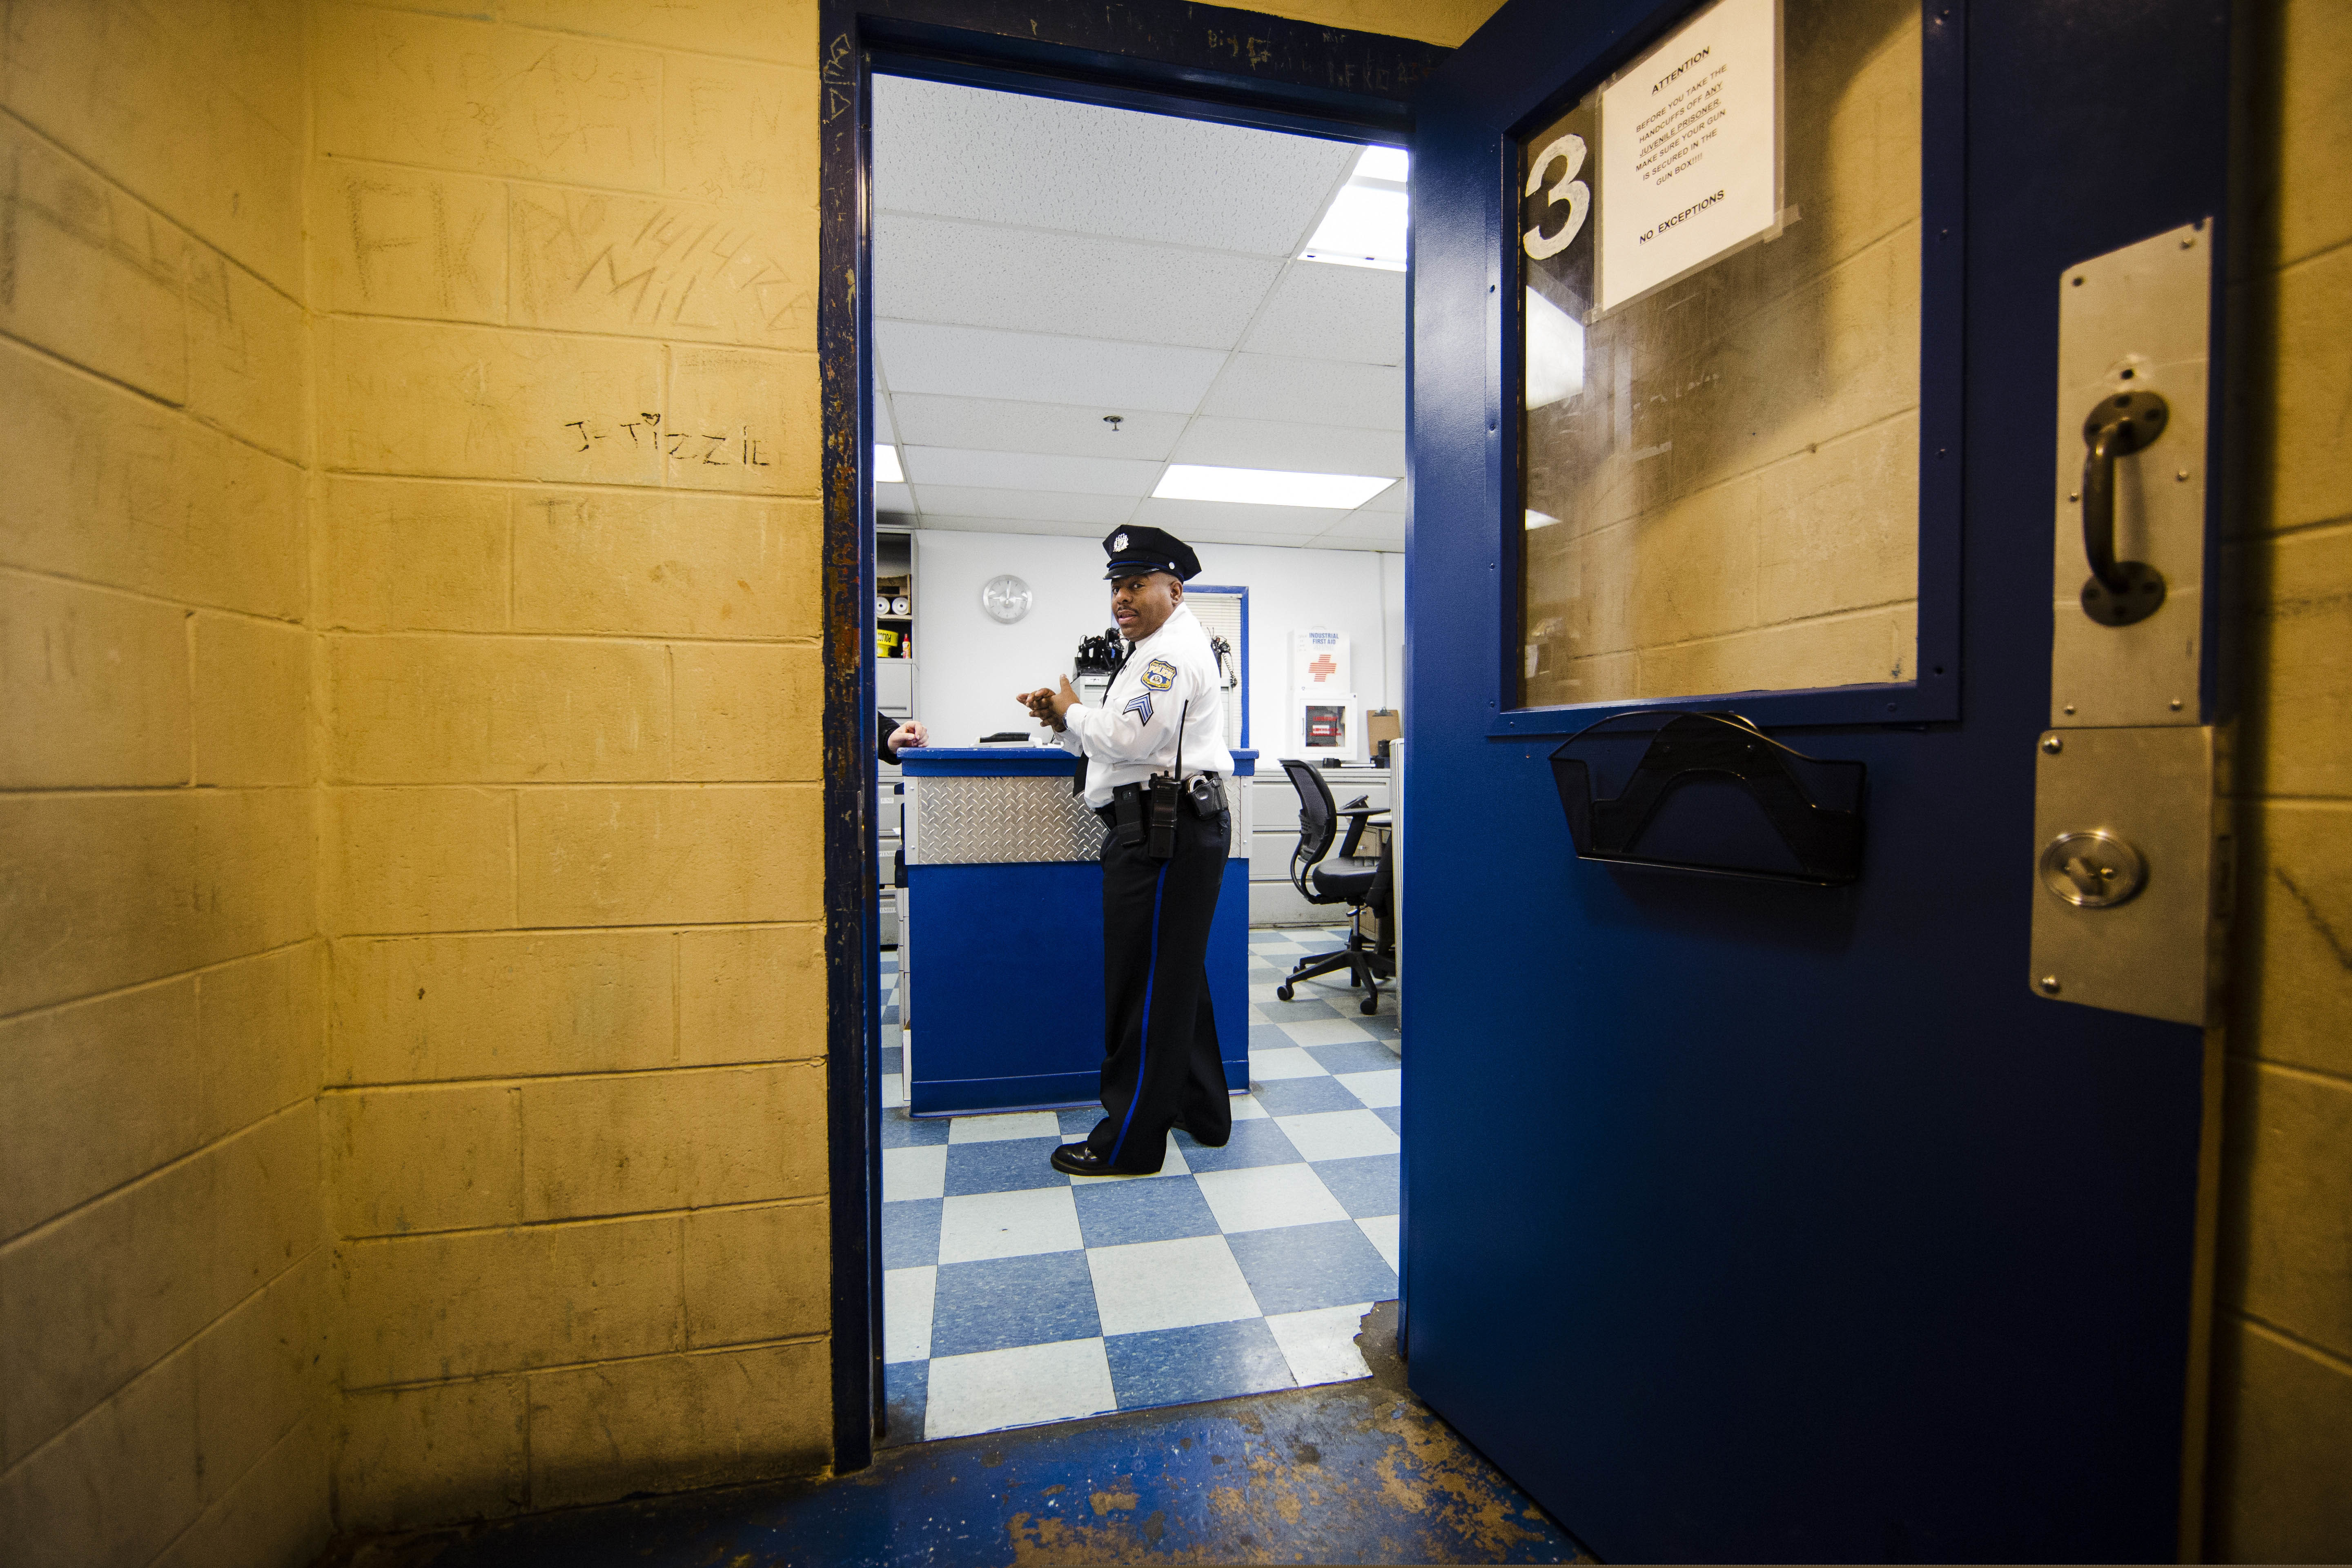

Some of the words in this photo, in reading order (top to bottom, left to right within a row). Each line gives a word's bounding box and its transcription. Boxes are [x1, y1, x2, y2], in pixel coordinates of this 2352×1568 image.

[1651, 45, 1710, 96] ATTENTION
[1636, 107, 1666, 133] BEFORE
[1668, 94, 1684, 110] YOU
[1686, 77, 1708, 96] TAKE
[1710, 64, 1727, 80] THE
[1639, 107, 1685, 144] HANDCUFFS
[1686, 95, 1702, 110] OFF
[1705, 81, 1723, 98] ANY
[1635, 153, 1658, 172] MAKE
[1659, 138, 1680, 157] SURE
[1682, 122, 1706, 141] YOUR
[1707, 109, 1726, 125] GUN
[1639, 127, 1676, 157] JUVENILE
[1643, 172, 1650, 181] IS
[1652, 147, 1689, 176] SECURED
[1691, 140, 1699, 151] IN
[1701, 128, 1718, 144] THE
[1523, 134, 1590, 260] 3
[1656, 171, 1673, 186] GUN
[1639, 229, 1654, 244] NO
[1658, 190, 1724, 234] EXCEPTIONS
[1148, 666, 1173, 679] POLICE
